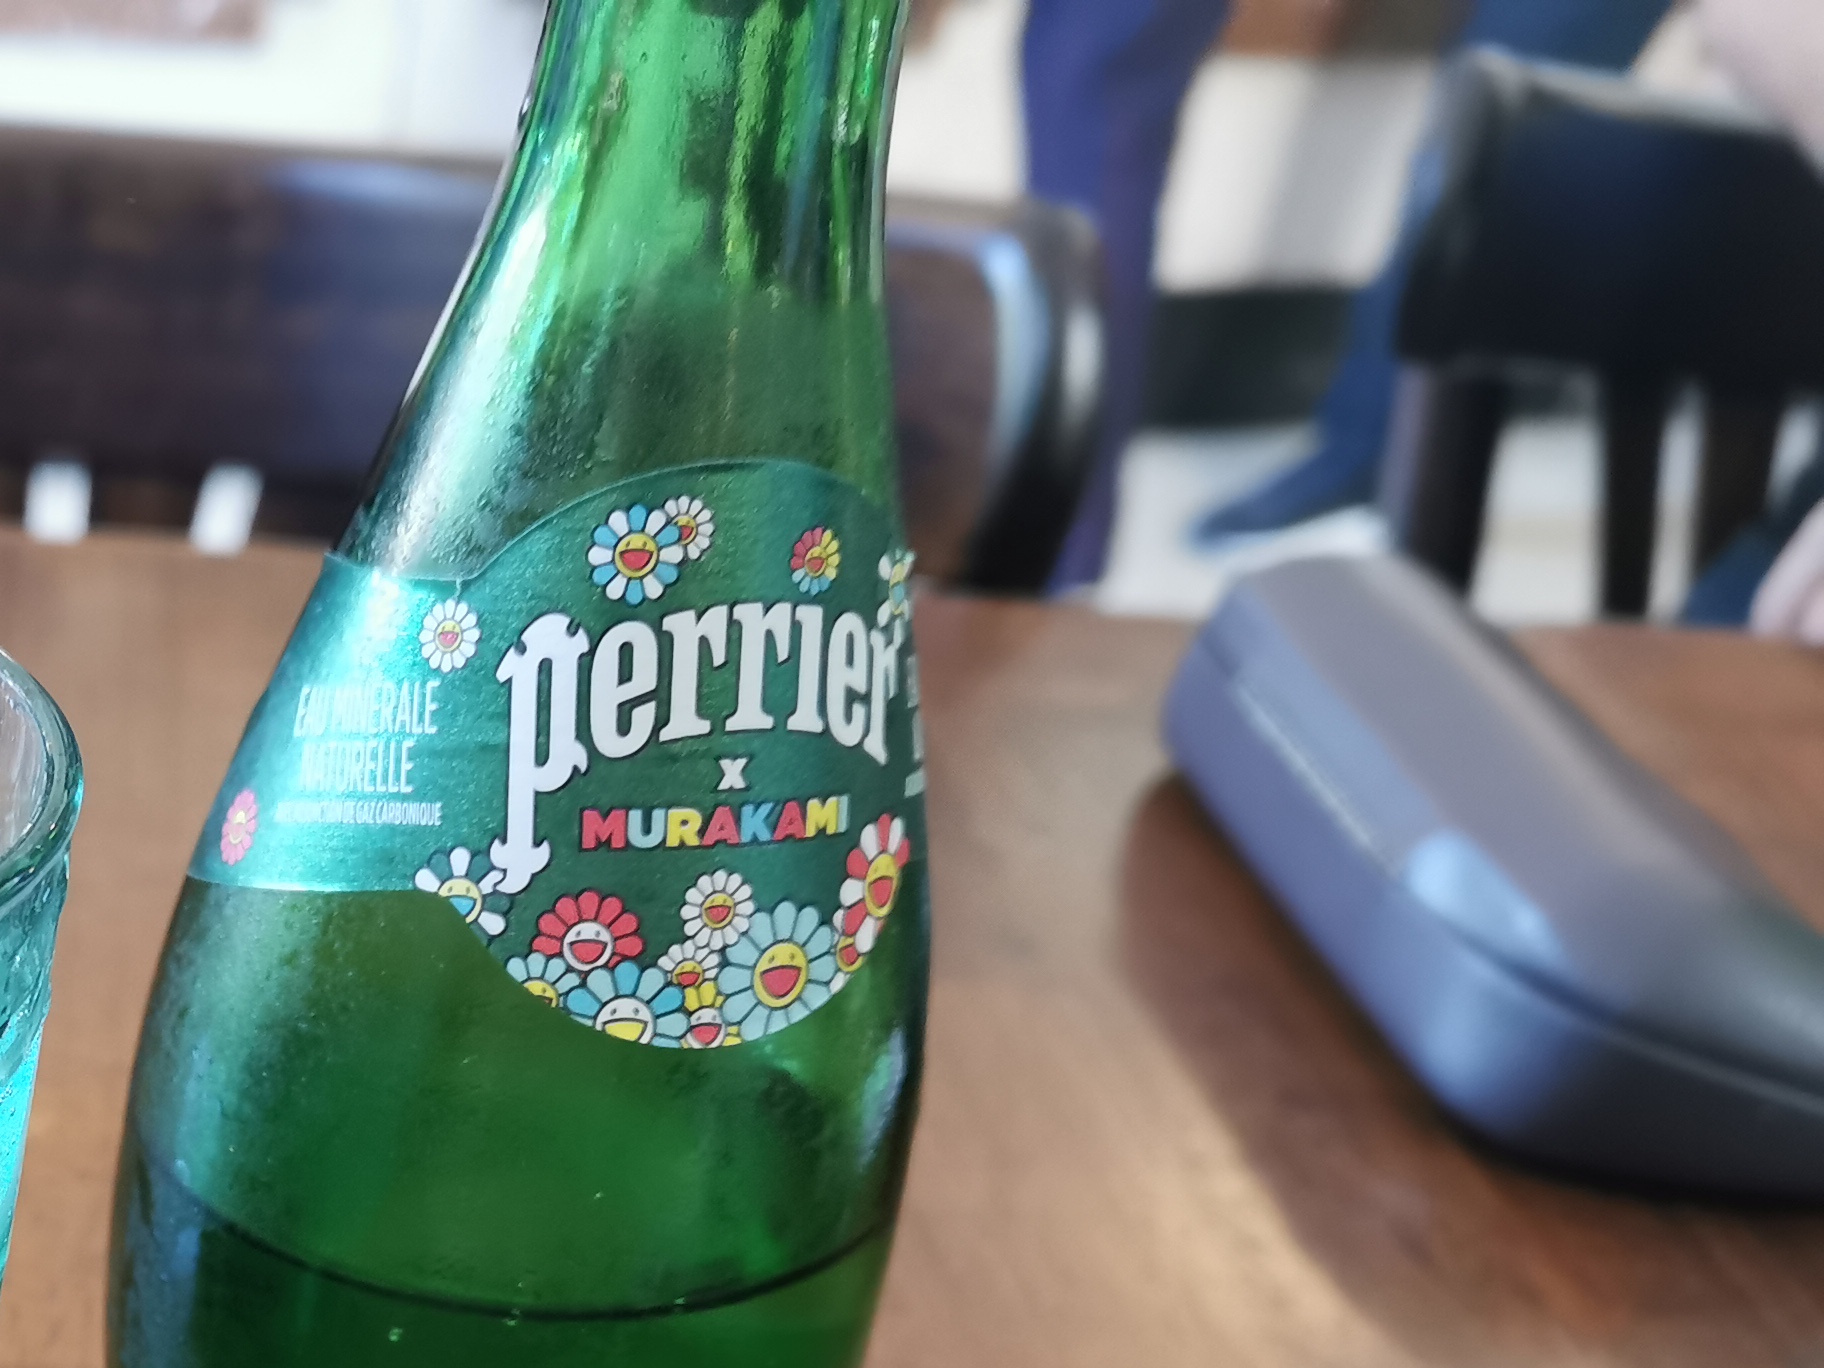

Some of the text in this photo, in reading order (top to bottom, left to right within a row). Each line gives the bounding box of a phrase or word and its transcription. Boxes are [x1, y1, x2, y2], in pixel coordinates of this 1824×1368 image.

[300, 740, 416, 793] NATURELLE
[376, 801, 443, 826] CARBONIQUE
[579, 793, 851, 852] MURAKAMI
